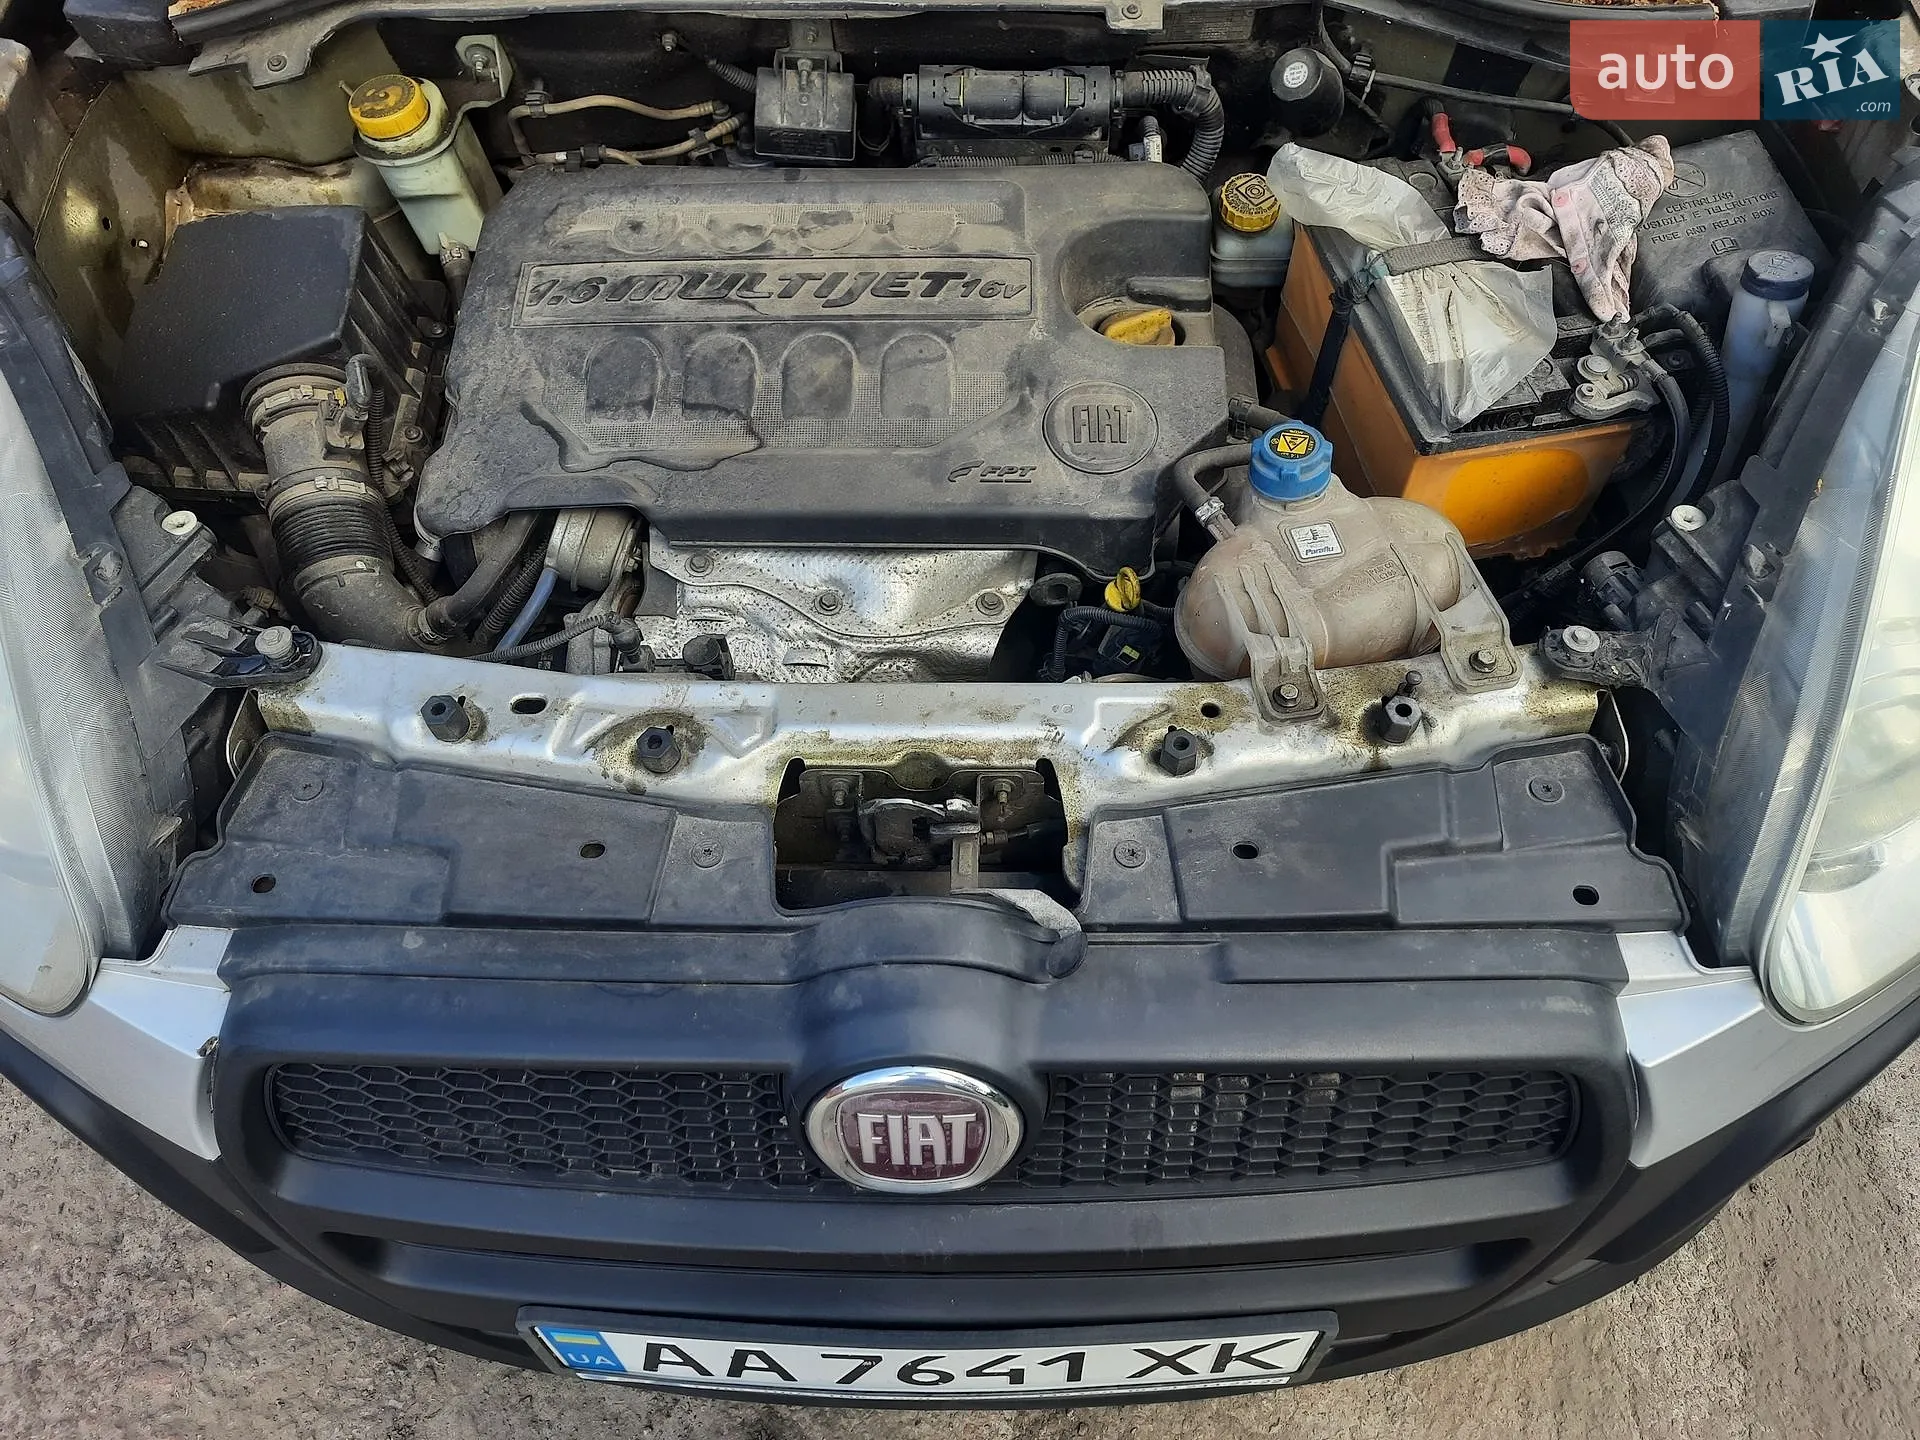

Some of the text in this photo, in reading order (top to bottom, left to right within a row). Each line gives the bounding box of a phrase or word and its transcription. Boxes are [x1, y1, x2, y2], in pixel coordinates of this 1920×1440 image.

[1665, 191, 1735, 214] CENTRALINA
[1651, 206, 1776, 245] FUSE AND RELAY BOX
[1693, 210, 1702, 219] E
[526, 276, 608, 306] 1.6
[605, 271, 968, 309] MULTIJET
[1072, 404, 1133, 444] FIAT
[979, 465, 1038, 478] FPT
[1305, 545, 1335, 556] Paraflu
[857, 1112, 977, 1166] FIAT
[569, 1353, 617, 1368] UA
